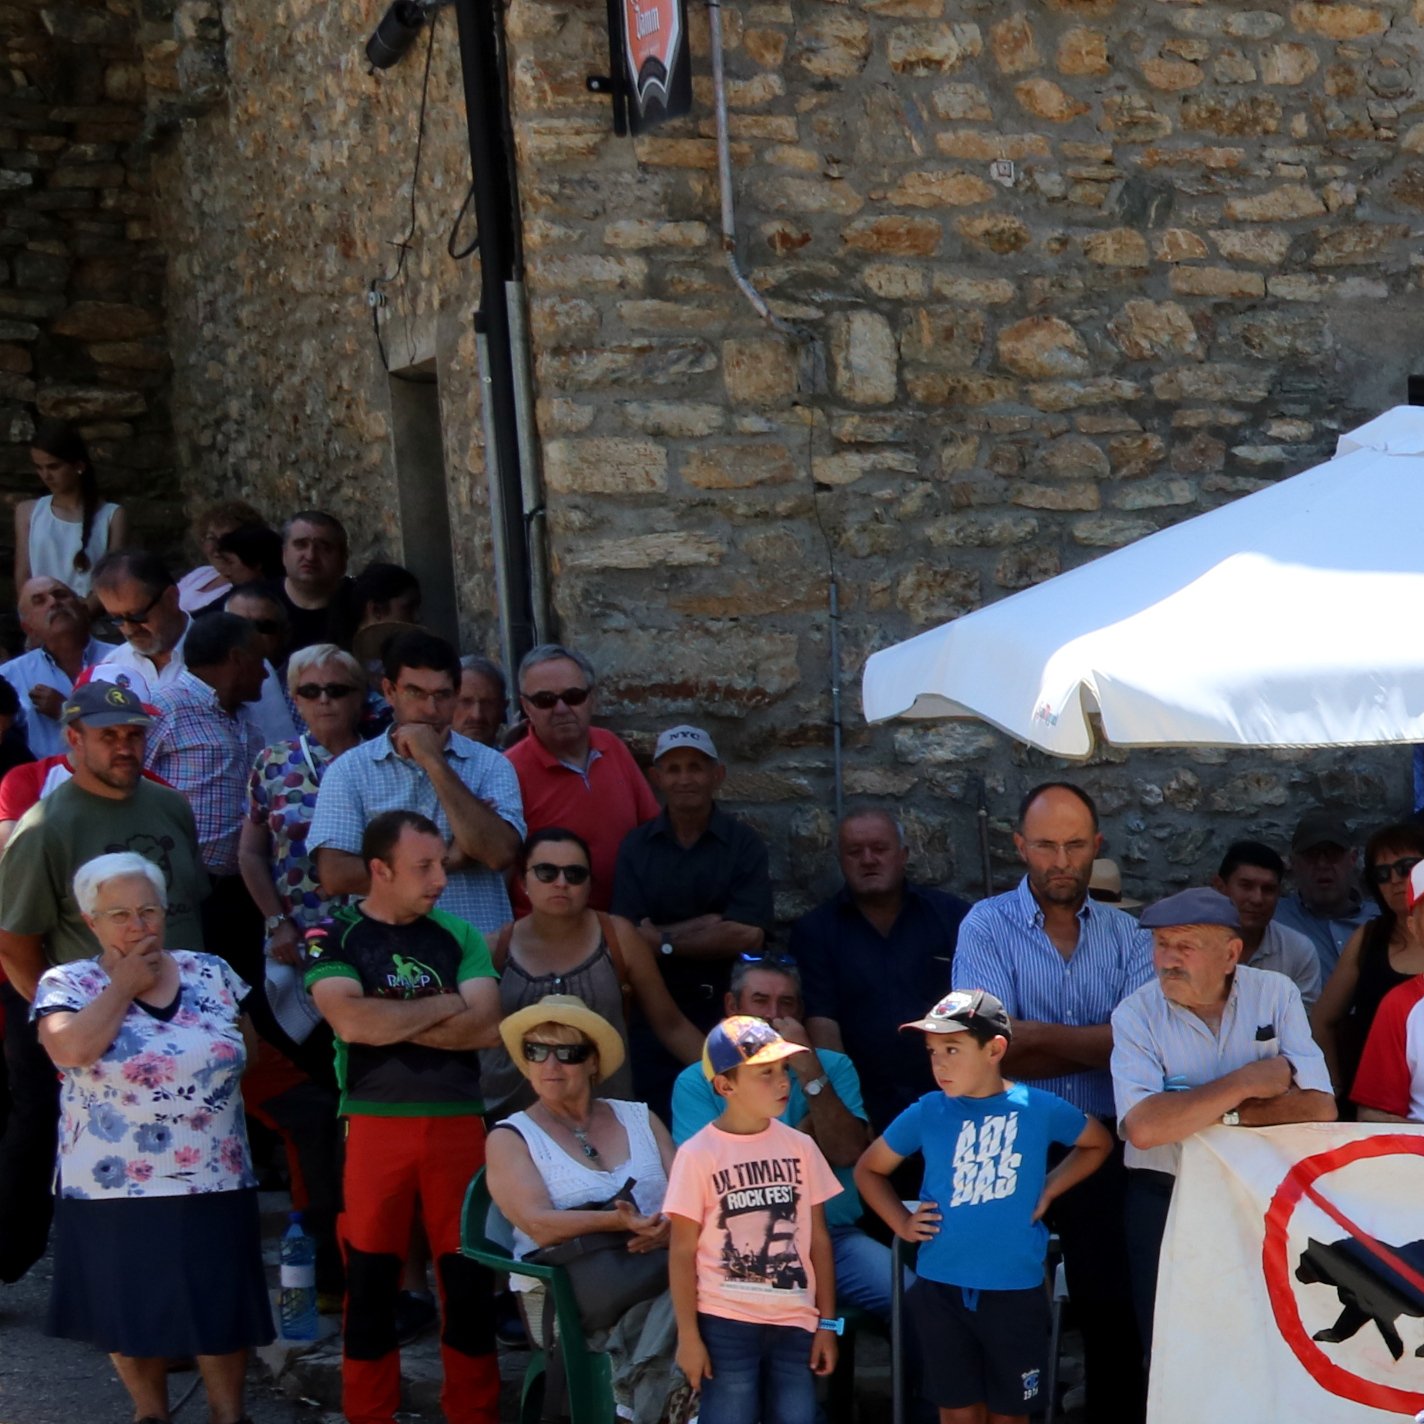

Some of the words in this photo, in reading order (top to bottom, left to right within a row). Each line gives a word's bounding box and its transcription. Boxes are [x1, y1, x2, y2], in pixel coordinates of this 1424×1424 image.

[669, 730, 700, 741] NYC
[712, 1158, 803, 1195] ULTIMATE
[727, 1189, 766, 1211] ROCK
